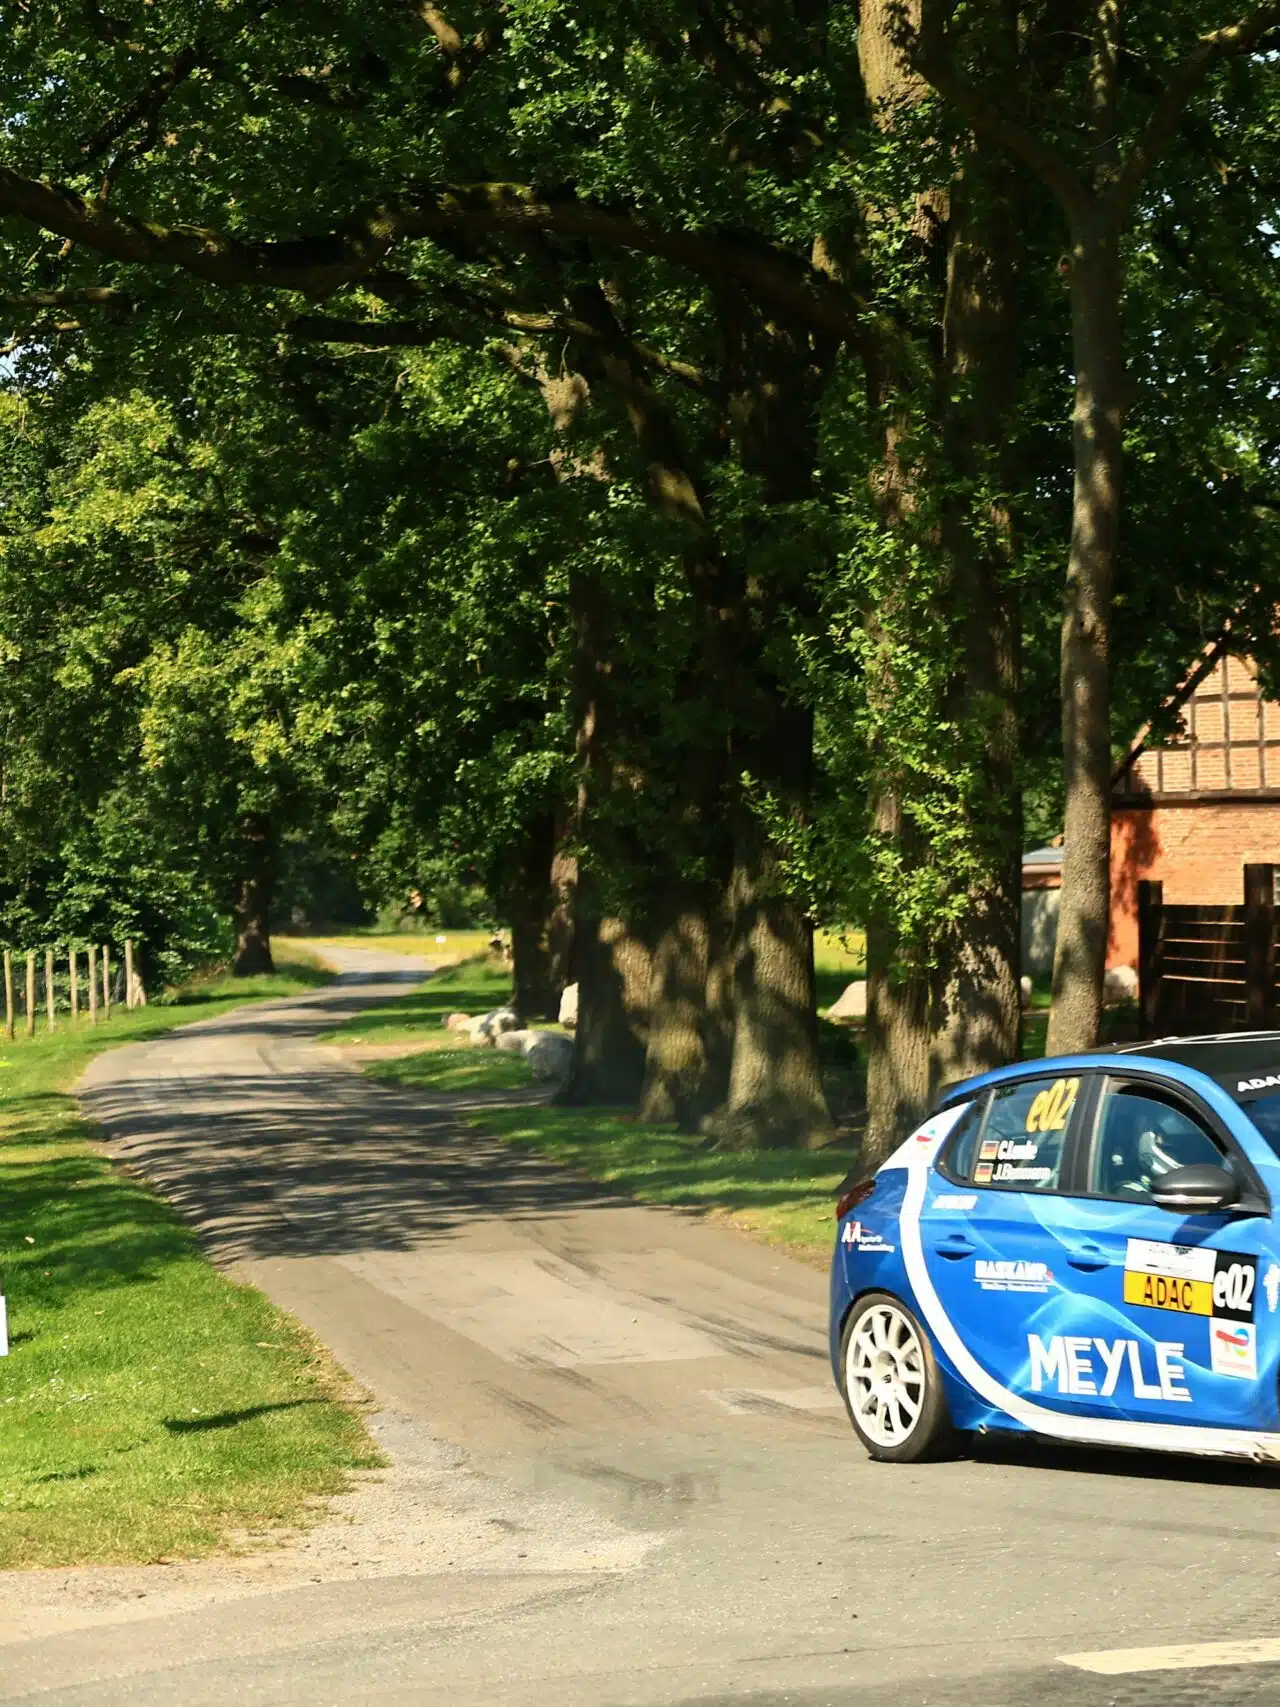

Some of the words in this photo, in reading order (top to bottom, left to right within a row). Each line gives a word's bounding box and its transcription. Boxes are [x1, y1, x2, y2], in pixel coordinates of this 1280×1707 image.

[1026, 1077, 1080, 1133] e02
[1143, 1276, 1193, 1311] ADAC
[1213, 1262, 1255, 1312] e02
[1027, 1333, 1193, 1402] MEYLE
